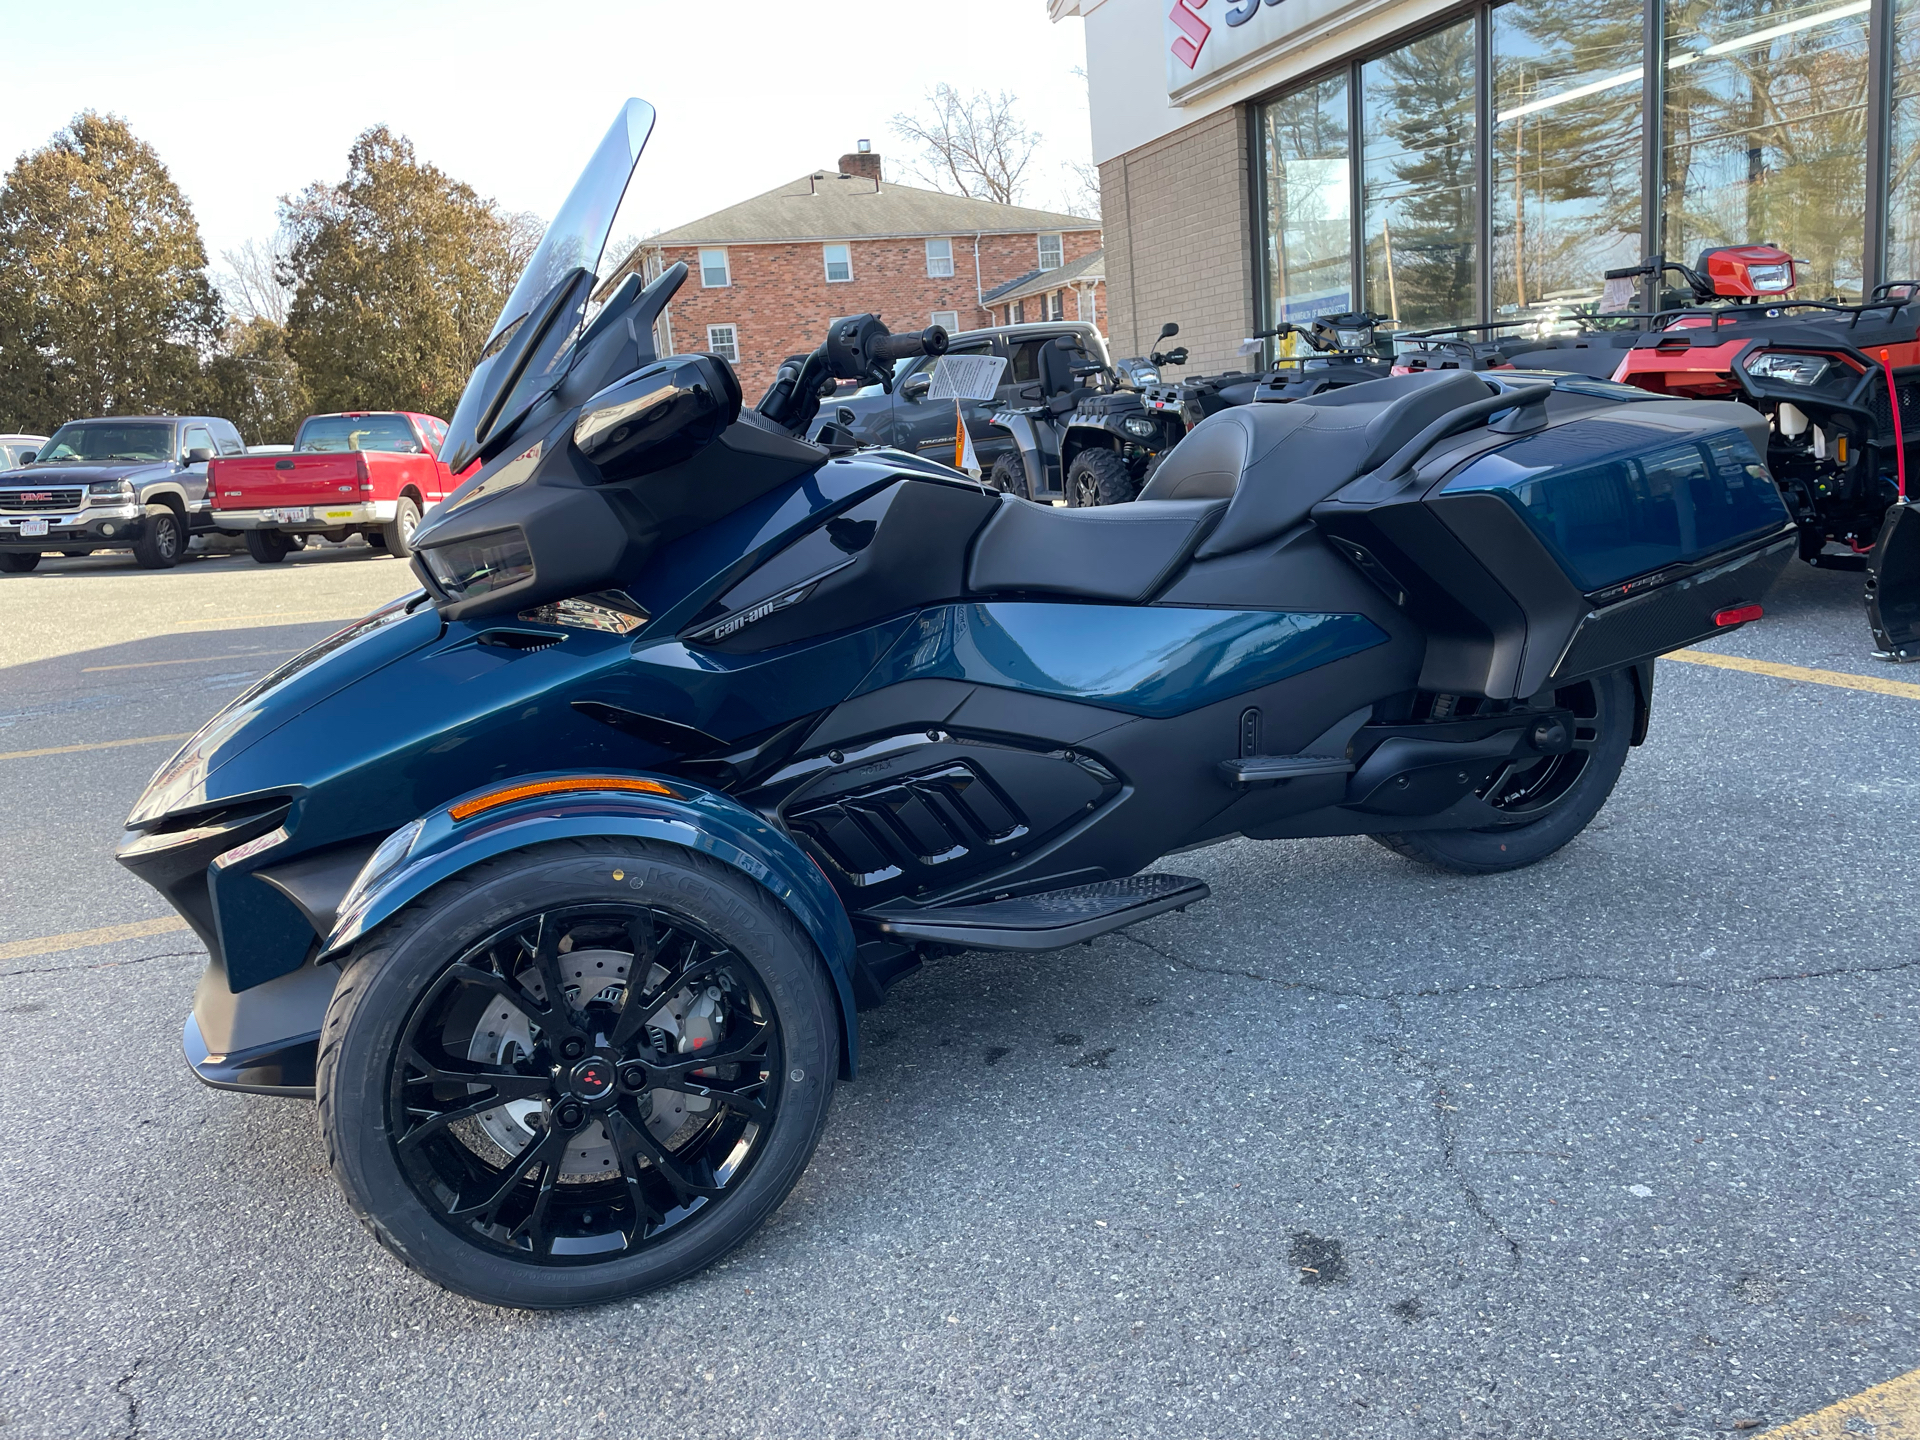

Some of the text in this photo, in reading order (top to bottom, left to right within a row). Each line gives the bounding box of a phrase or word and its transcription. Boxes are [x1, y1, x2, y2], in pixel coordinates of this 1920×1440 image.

[20, 492, 53, 501] GMC
[714, 601, 774, 640] can-am
[860, 761, 892, 776] ROTAX
[645, 867, 775, 957] KENDA
[783, 967, 821, 1121] RADIAL
